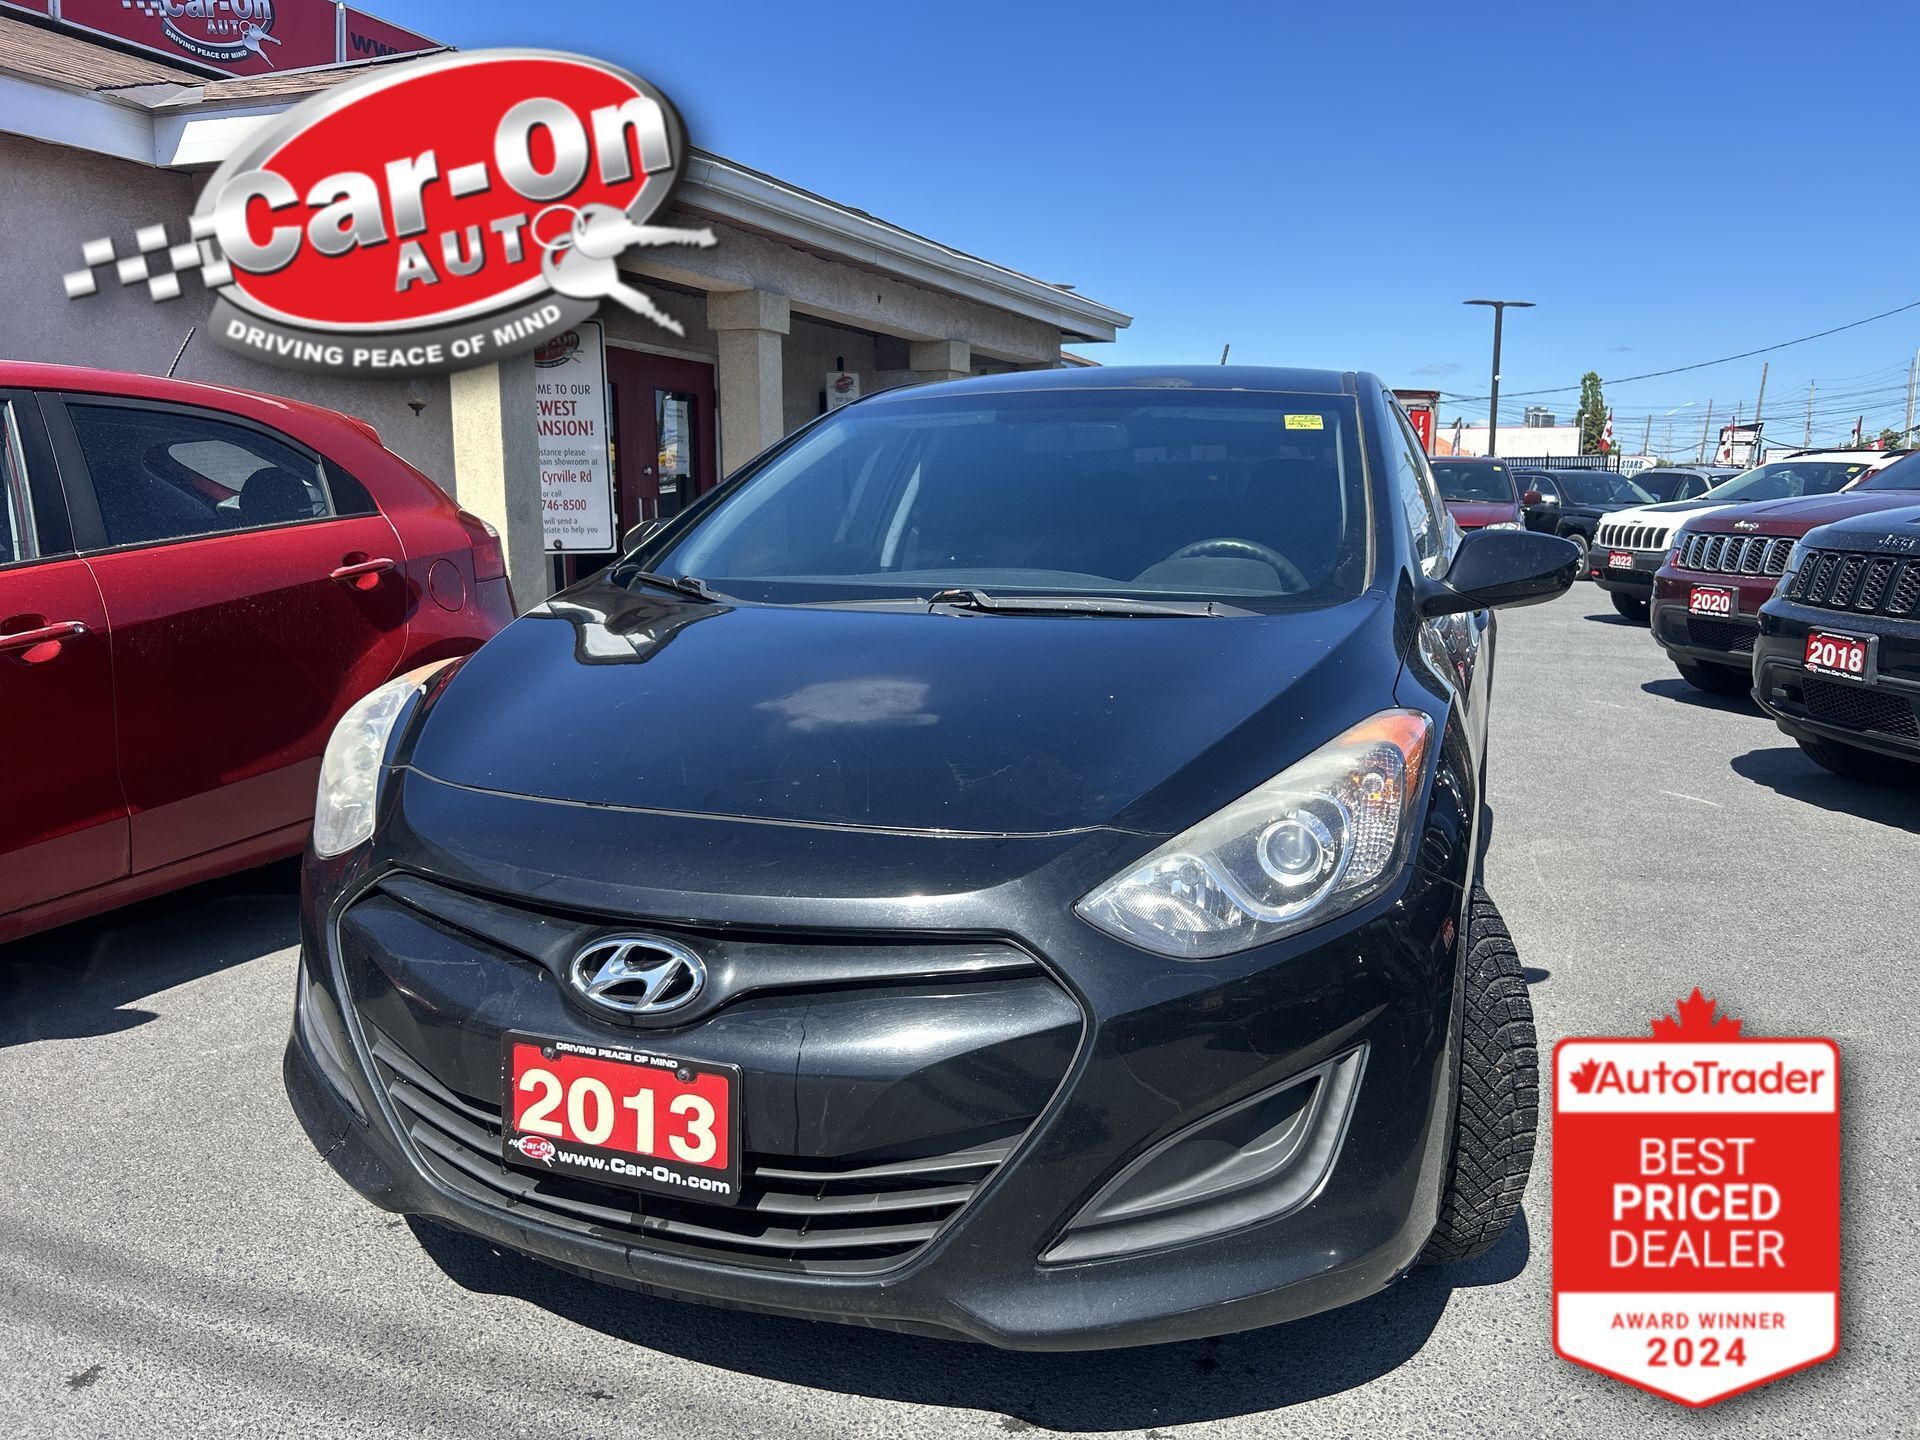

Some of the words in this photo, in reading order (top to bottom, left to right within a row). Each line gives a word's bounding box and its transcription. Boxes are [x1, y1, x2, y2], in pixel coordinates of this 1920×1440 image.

[165, 29, 196, 52] DRIVING
[197, 48, 220, 59] PEACE
[231, 49, 247, 60] MIND
[536, 384, 551, 394] ME
[555, 384, 566, 394] TO
[571, 384, 591, 395] OUR
[564, 448, 586, 457] please
[1621, 460, 1644, 469] STARS
[542, 470, 577, 486] Cyrville
[580, 470, 592, 482] Rd
[551, 490, 562, 498] call
[542, 500, 587, 511] 746-8500
[557, 517, 572, 525] send
[571, 526, 585, 535] help
[587, 527, 599, 535] you
[1610, 555, 1632, 566] 2022
[1692, 593, 1730, 612] 2020
[1808, 641, 1863, 672] 2018
[1817, 668, 1863, 682] www.Car-On.com
[556, 1041, 597, 1056] DRIVING
[599, 1048, 632, 1061] PEACE
[633, 1054, 649, 1064] OF
[650, 1057, 678, 1069] MIND
[518, 1068, 717, 1163] 2013
[519, 1138, 553, 1152] Car-On
[558, 1150, 731, 1195] www.Car-On.com
